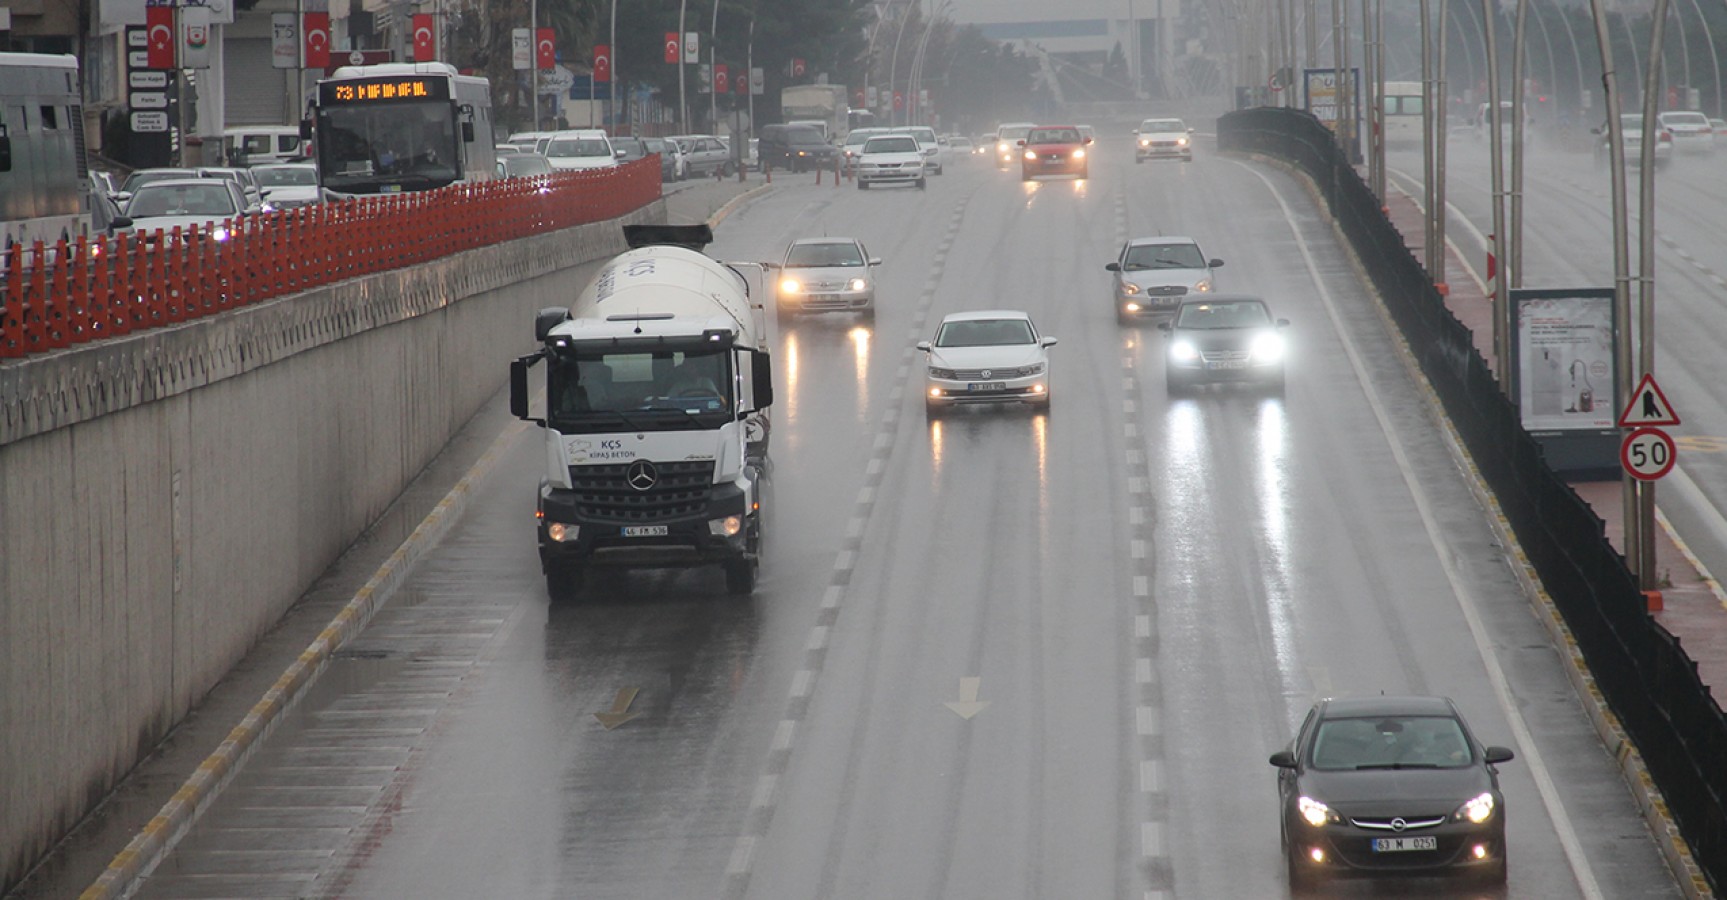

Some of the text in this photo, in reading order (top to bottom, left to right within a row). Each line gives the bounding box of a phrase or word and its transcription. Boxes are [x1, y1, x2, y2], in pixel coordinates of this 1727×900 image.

[601, 440, 622, 450] KÇS
[611, 450, 636, 458] BETON
[1632, 441, 1667, 468] 50
[1378, 839, 1390, 850] 63
[1413, 838, 1436, 849] 0251
